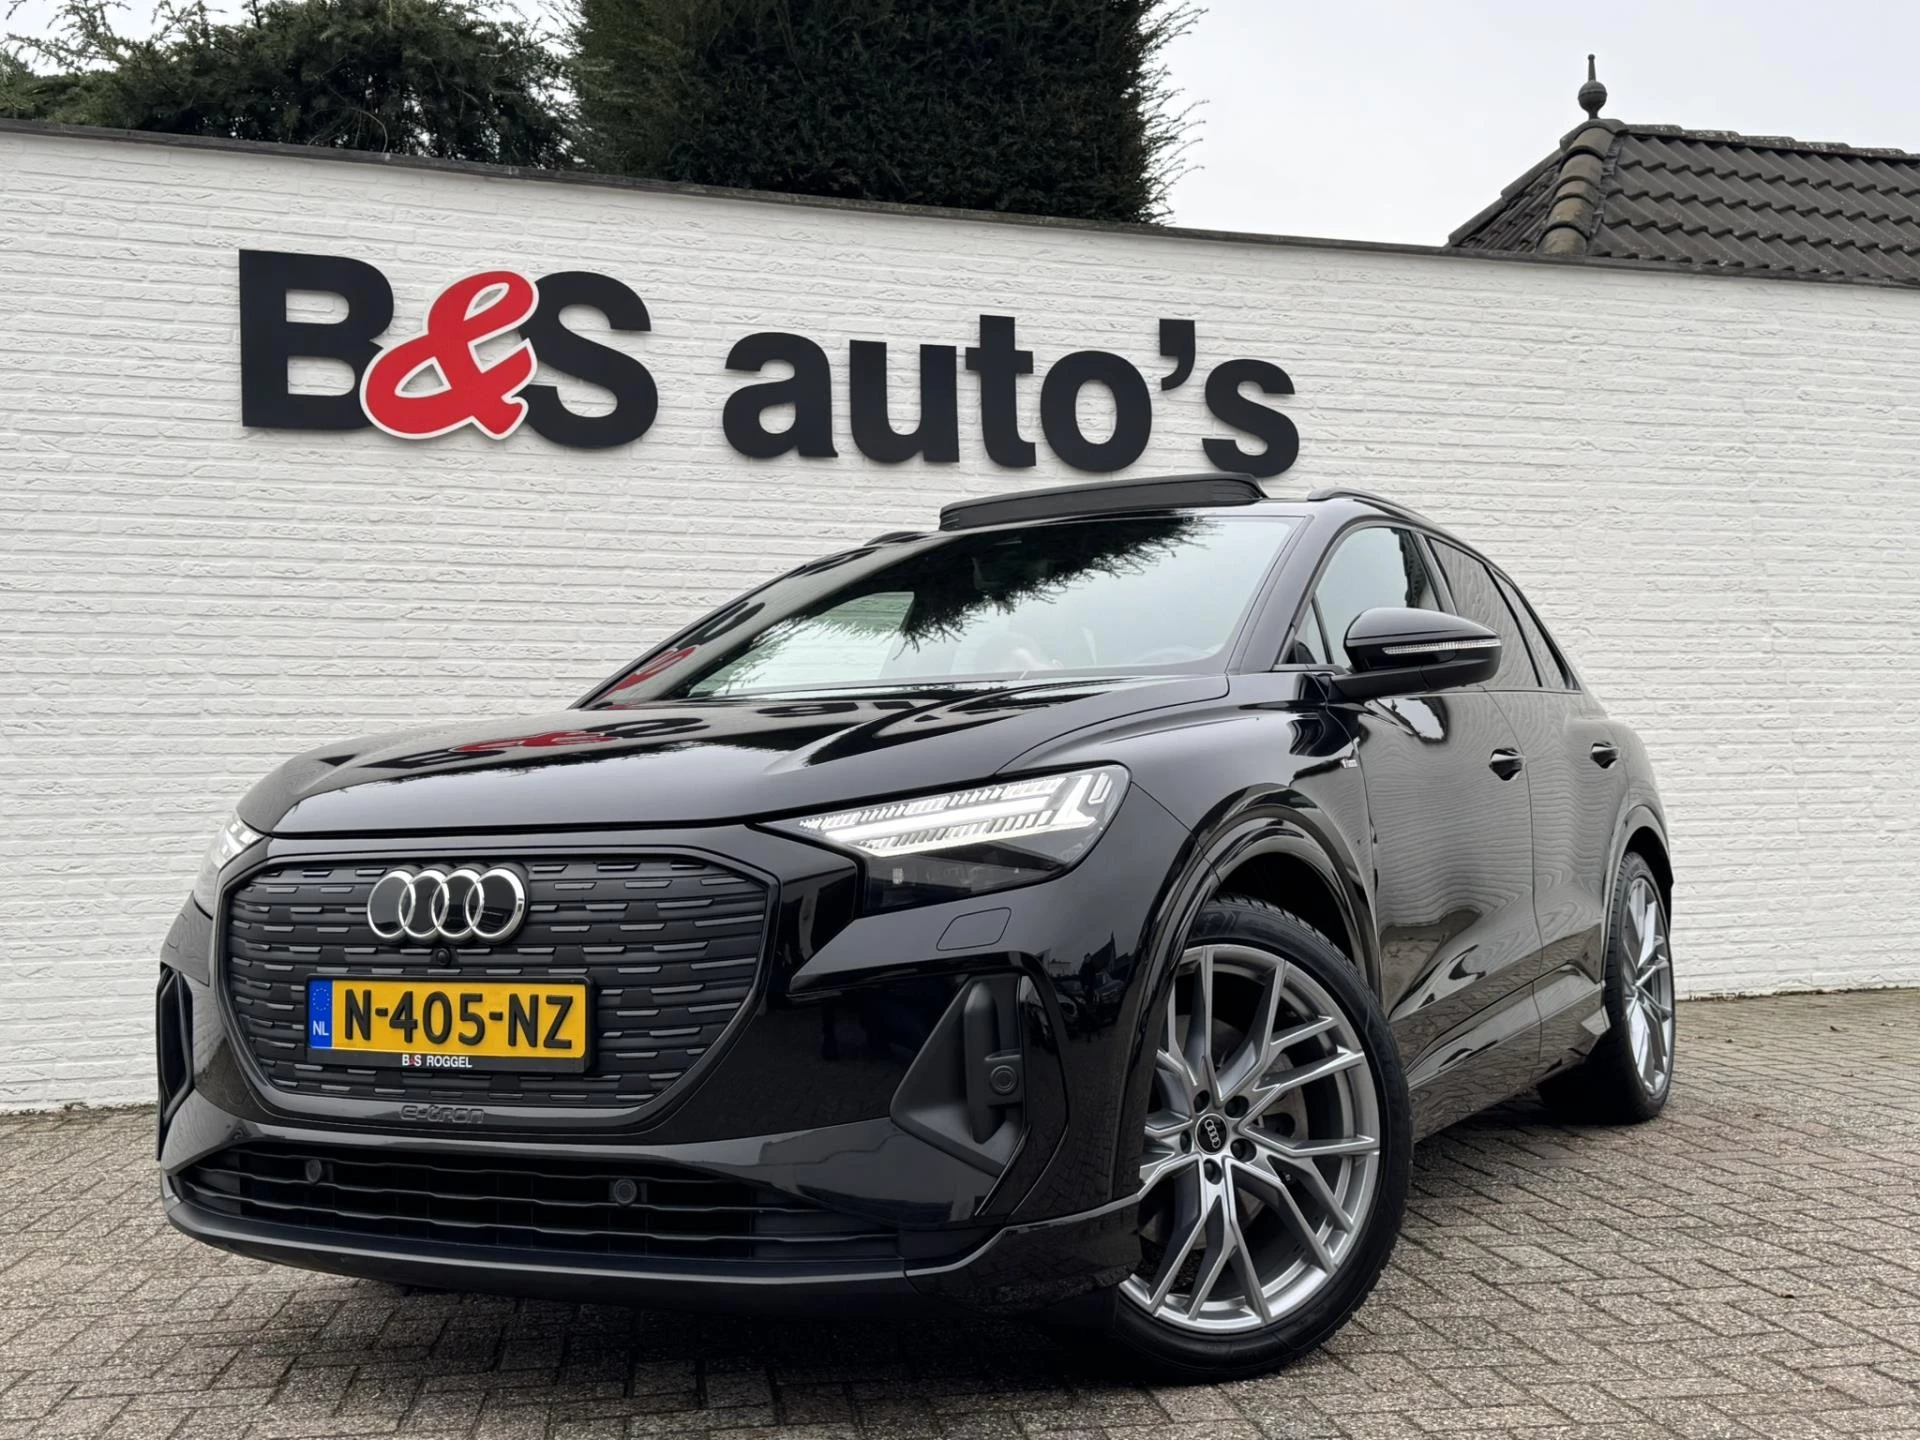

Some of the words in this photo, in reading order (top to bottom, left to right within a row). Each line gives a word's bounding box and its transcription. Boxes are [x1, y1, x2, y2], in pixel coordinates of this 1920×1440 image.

[239, 249, 658, 449] B&S
[722, 314, 1300, 477] auto's
[313, 1020, 329, 1036] NL
[345, 989, 574, 1049] N-405-NZ
[426, 1056, 473, 1068] ROGGEL
